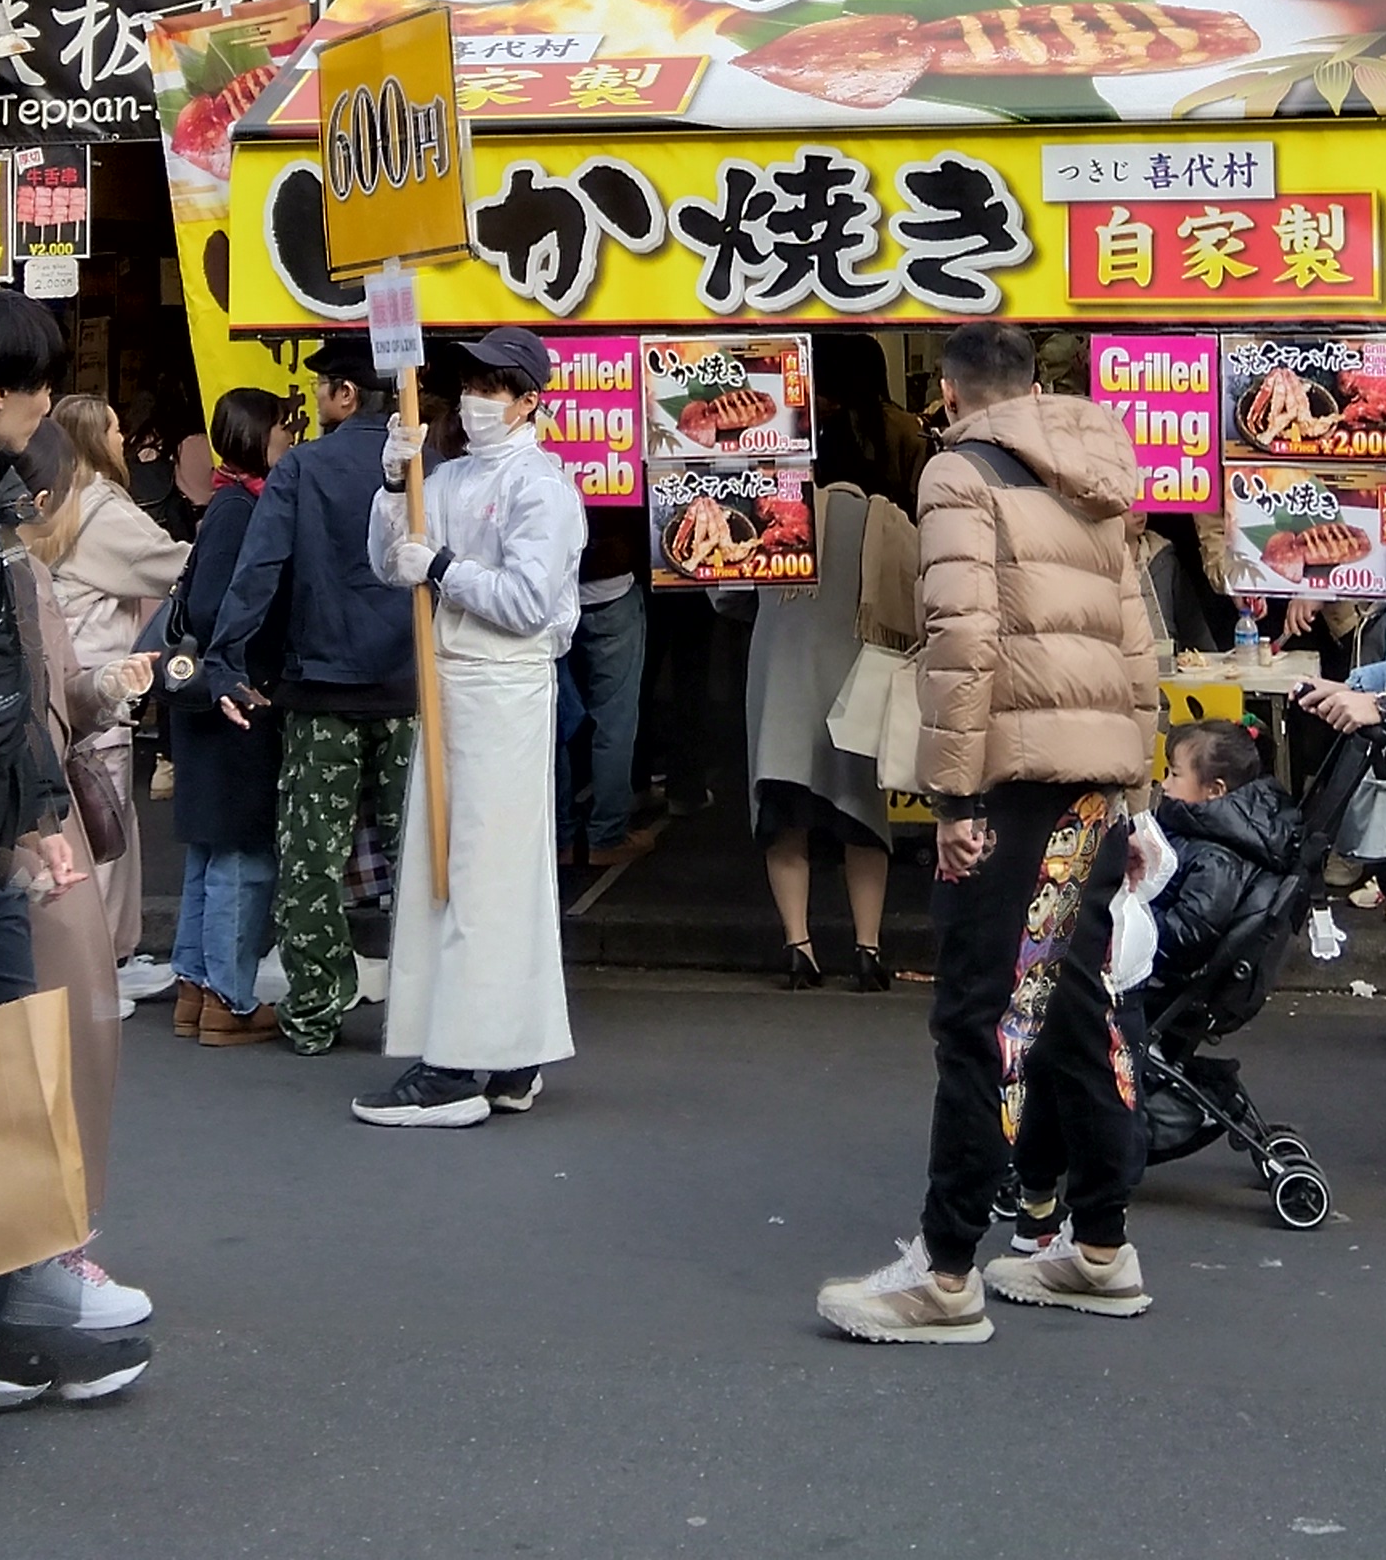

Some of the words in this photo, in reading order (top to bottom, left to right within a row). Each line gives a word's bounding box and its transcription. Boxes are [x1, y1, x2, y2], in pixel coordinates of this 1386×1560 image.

[328, 76, 449, 202] 600円
[1058, 158, 1130, 183] つきじ
[1143, 152, 1258, 189] 喜代村
[1096, 203, 1354, 289] 自家製
[549, 349, 633, 391] Grilled
[647, 347, 748, 388] いか焼き
[1099, 347, 1210, 393] Grilled
[1228, 342, 1362, 375] 焼タラバガニ
[535, 399, 634, 451] King
[548, 452, 635, 497] rab
[1136, 457, 1211, 502] rab
[1230, 471, 1340, 519] いか焼き
[742, 553, 812, 579] ¥2,000
